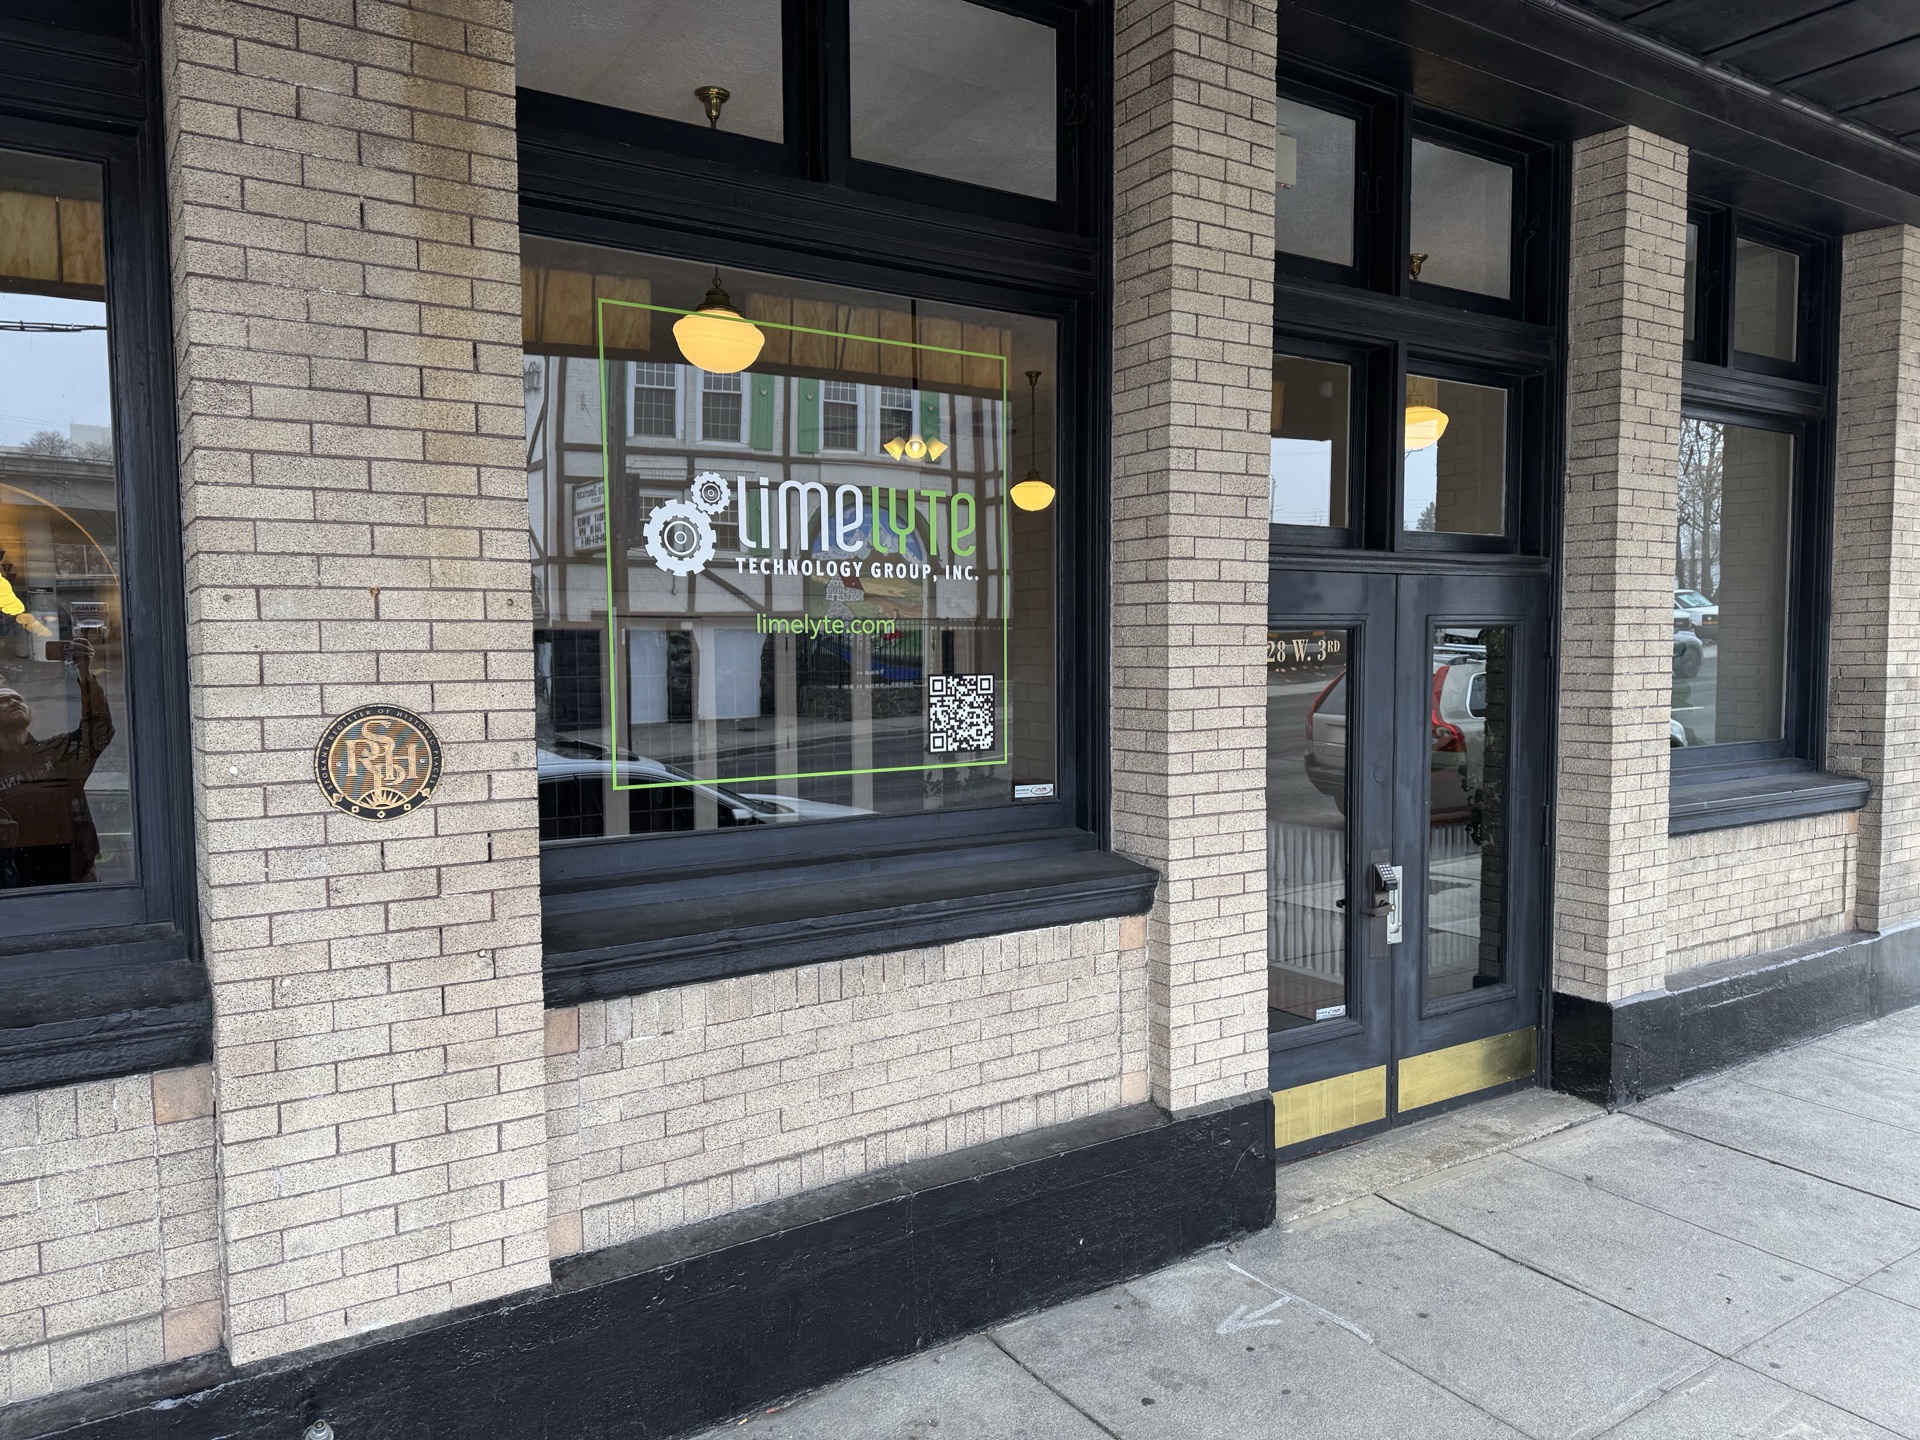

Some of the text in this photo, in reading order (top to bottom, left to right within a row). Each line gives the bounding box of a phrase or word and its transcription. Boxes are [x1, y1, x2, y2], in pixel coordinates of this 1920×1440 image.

[735, 557, 979, 582] TECHNOLOGY GROUP, INC.
[756, 613, 895, 639] limelyte.com
[1292, 639, 1311, 662] W.
[321, 745, 333, 790] SPOKANE
[328, 710, 371, 741] REGISTER
[397, 711, 435, 746] HISTORIC
[431, 750, 439, 785] PLACES
